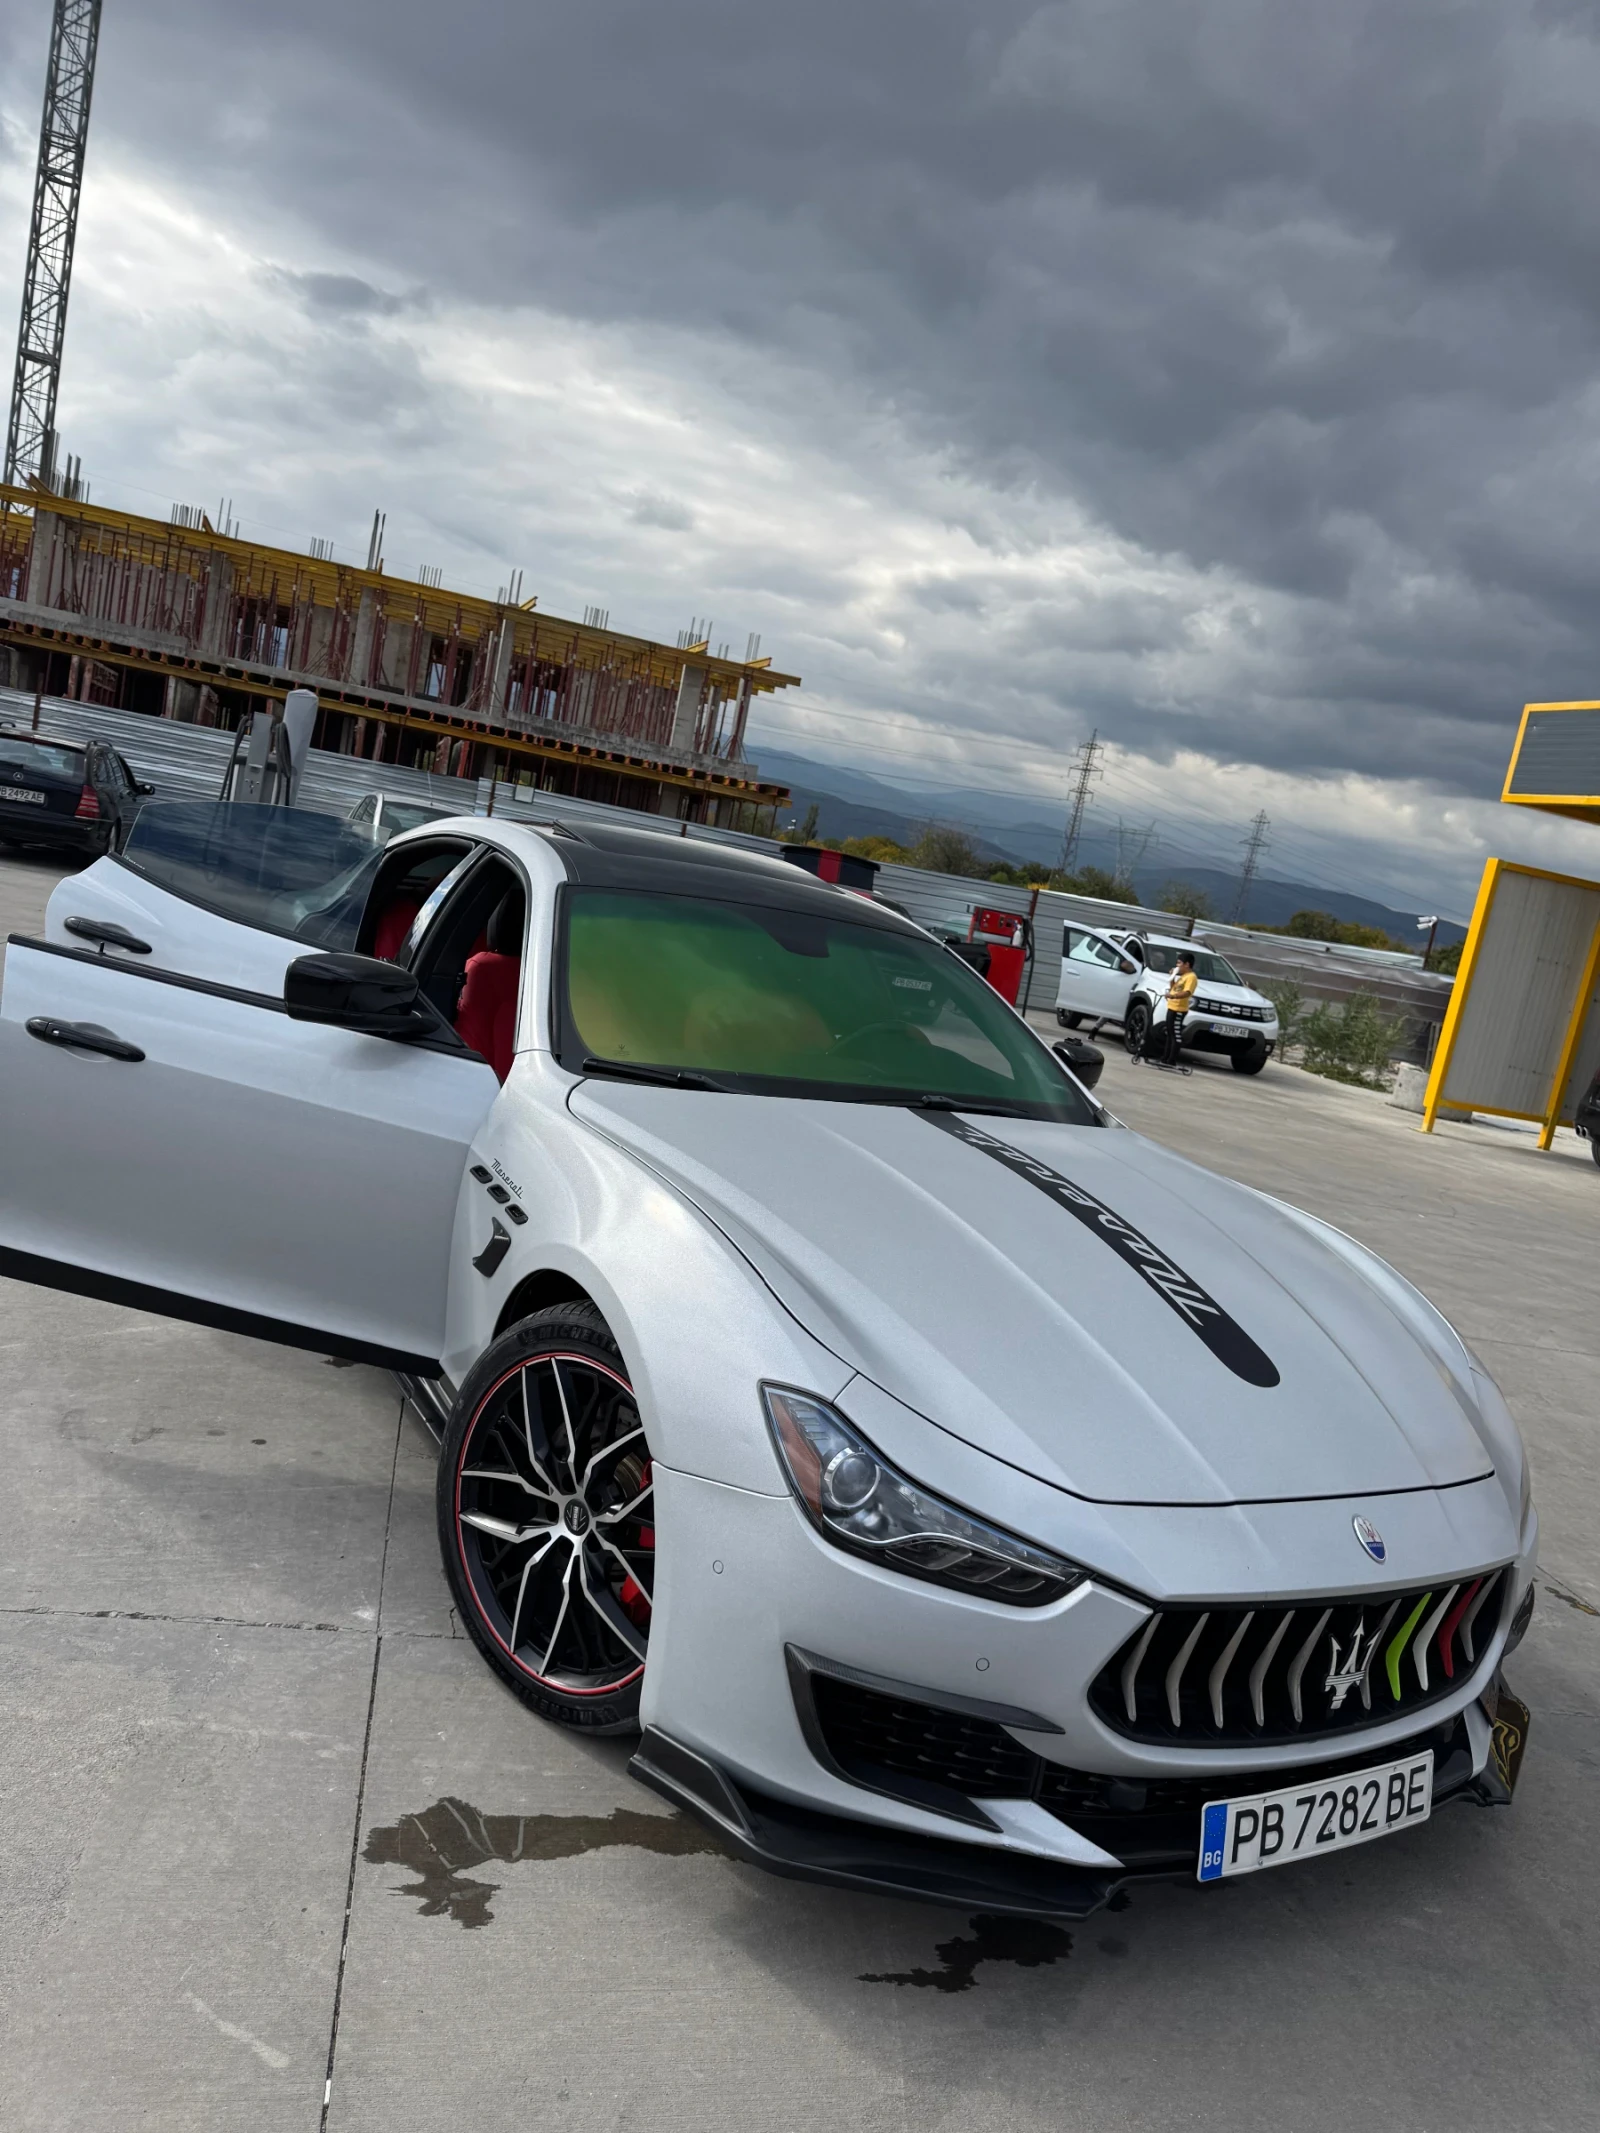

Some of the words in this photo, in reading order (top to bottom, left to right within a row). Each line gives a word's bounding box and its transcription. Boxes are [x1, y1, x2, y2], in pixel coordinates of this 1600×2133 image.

[8, 788, 30, 799] 2492
[31, 791, 43, 801] AE
[491, 1158, 523, 1199] Maserati
[1231, 1803, 1284, 1864] PB
[1292, 1779, 1381, 1850] 7282
[1385, 1763, 1427, 1824] BE
[1203, 1849, 1222, 1868] BG
